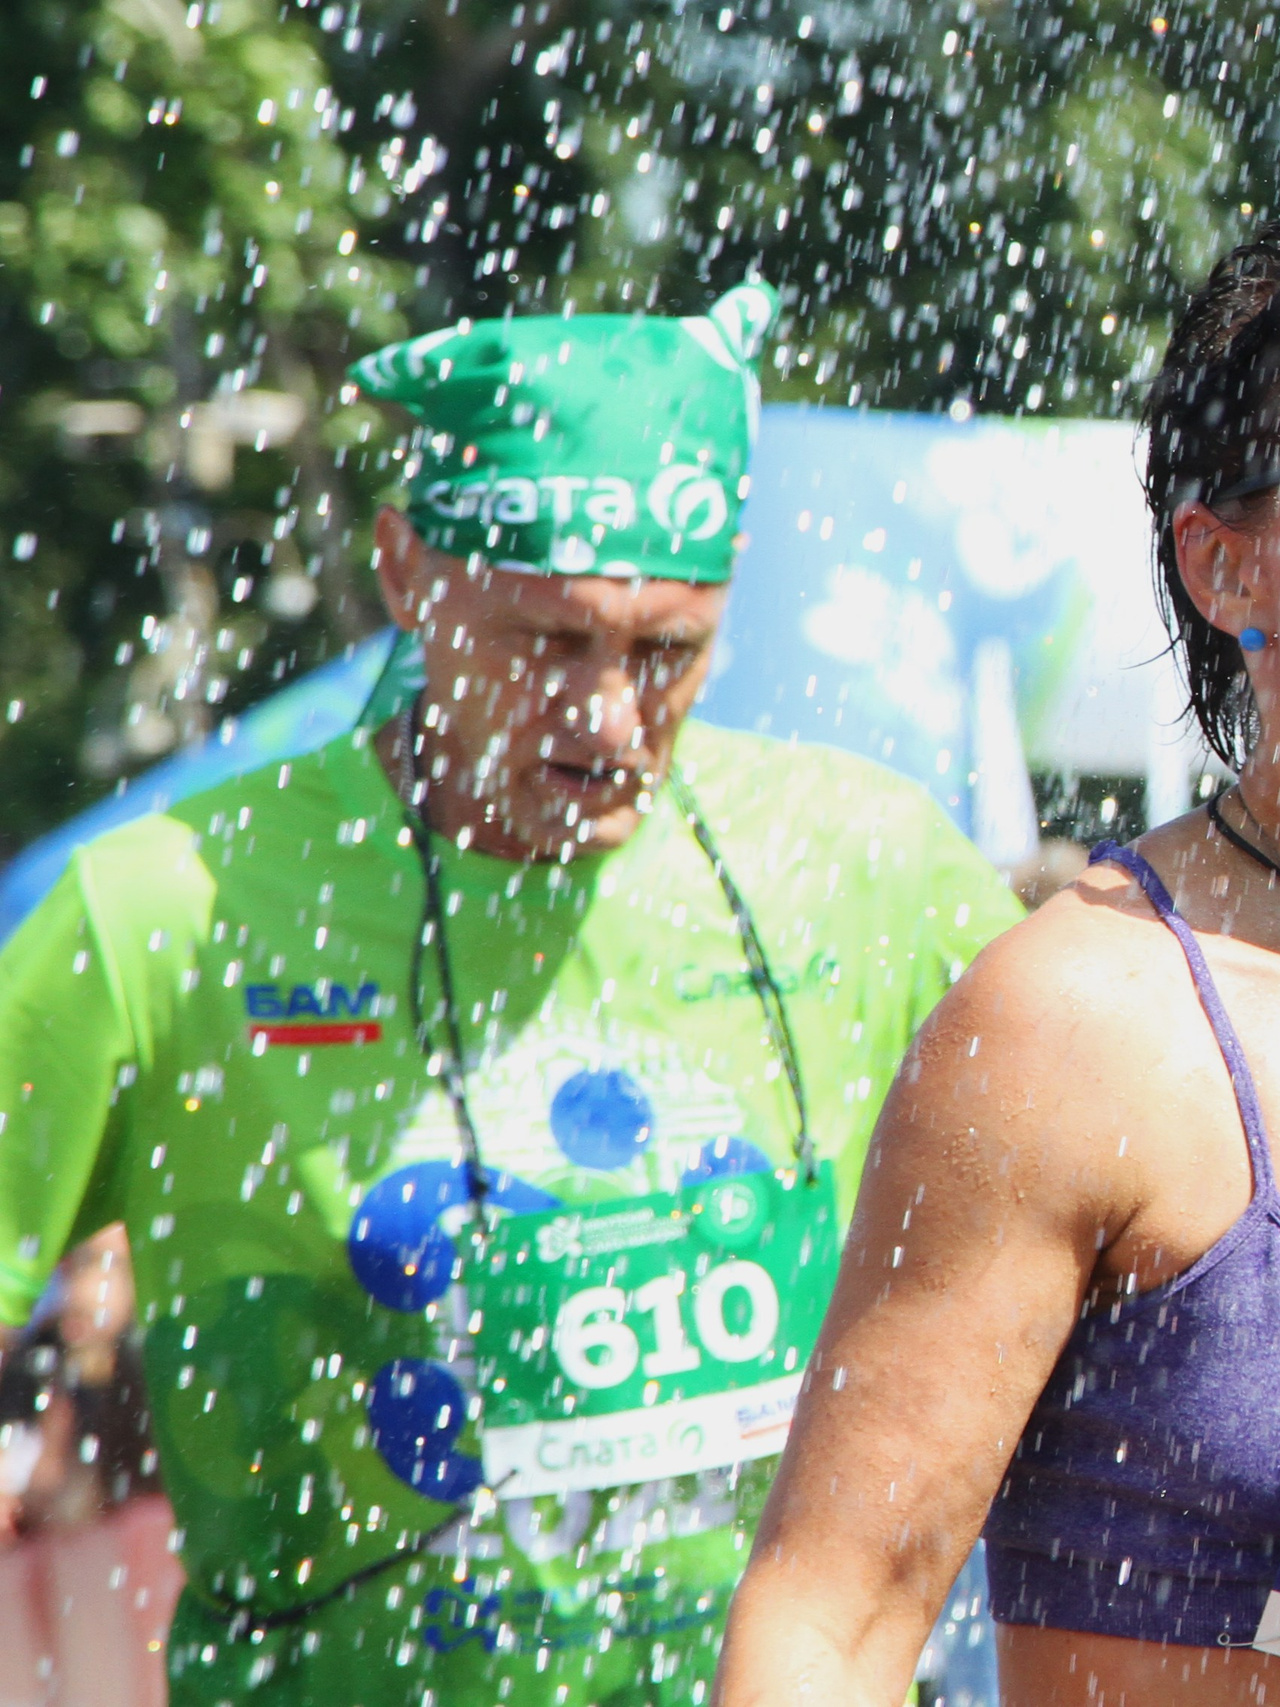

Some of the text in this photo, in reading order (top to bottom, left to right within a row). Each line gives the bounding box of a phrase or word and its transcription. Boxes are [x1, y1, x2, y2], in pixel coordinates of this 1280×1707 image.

[246, 983, 378, 1018] БАМ
[556, 1260, 778, 1389] 610
[537, 1432, 659, 1472] Слата
